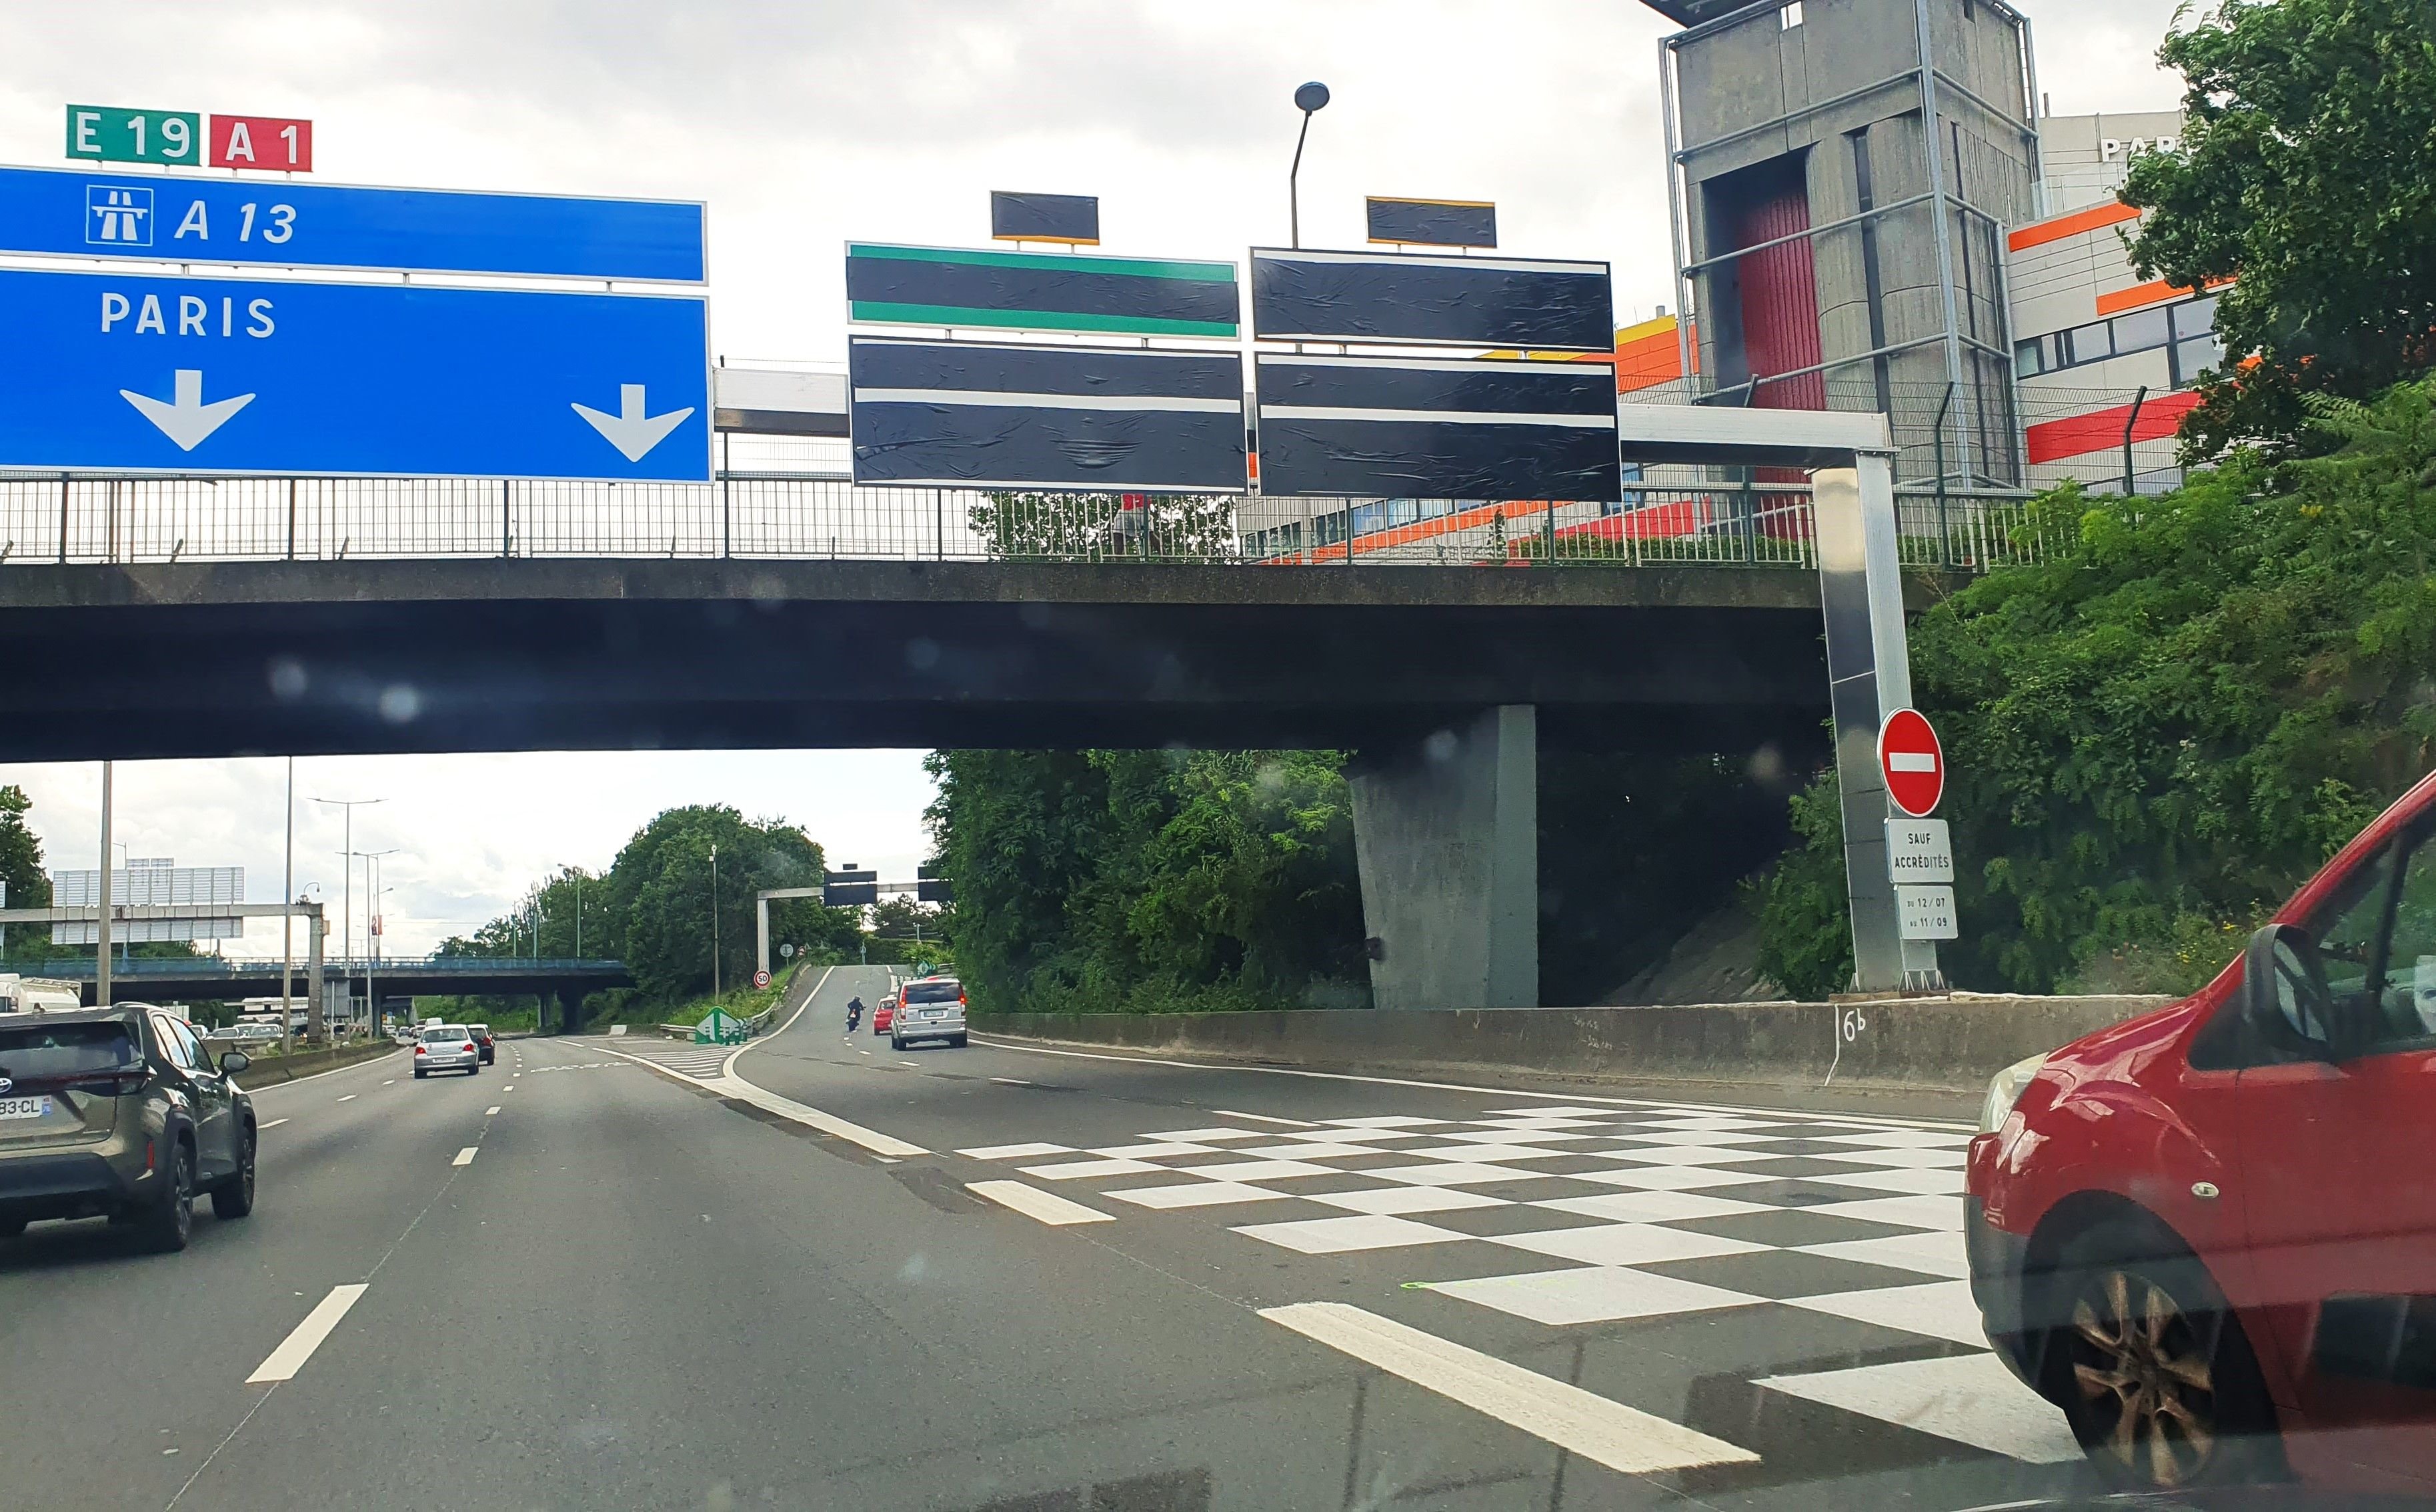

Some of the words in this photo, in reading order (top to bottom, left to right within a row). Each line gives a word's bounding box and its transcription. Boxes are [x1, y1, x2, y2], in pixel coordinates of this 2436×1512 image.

[76, 111, 102, 153] E
[127, 115, 191, 158] 19
[225, 122, 256, 161] A
[279, 125, 297, 165] 1
[173, 200, 209, 240] A
[239, 203, 297, 244] 13
[101, 292, 275, 339] PARIS
[1895, 853, 1949, 868] ACCRÉDITÉS
[1908, 833, 1931, 845] SAUF
